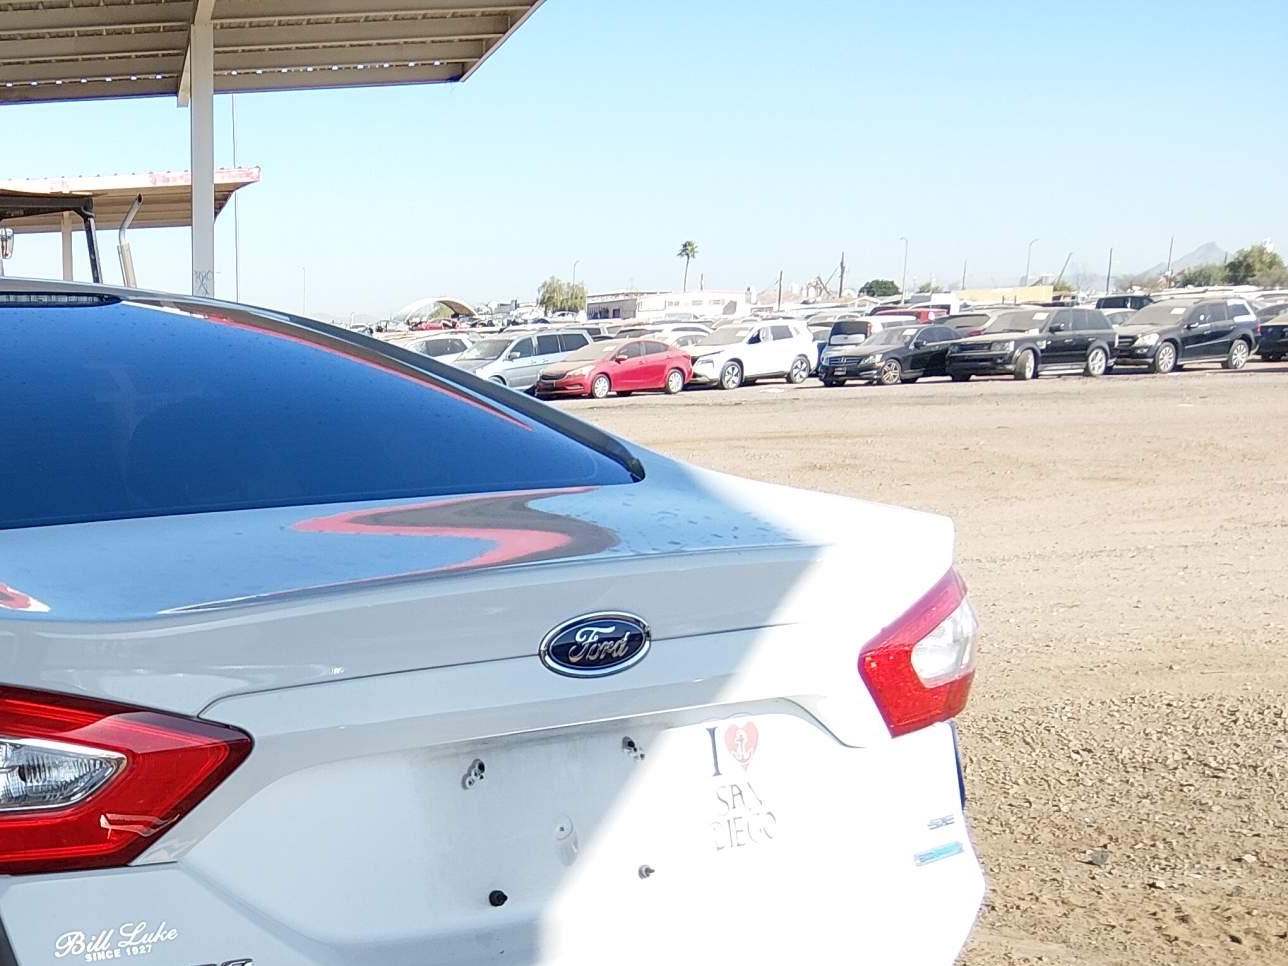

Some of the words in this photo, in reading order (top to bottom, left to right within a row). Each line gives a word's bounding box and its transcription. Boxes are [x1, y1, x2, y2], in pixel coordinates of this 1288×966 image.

[568, 625, 631, 663] Ford
[54, 928, 114, 958] Bill
[117, 921, 179, 948] Luke
[85, 948, 121, 962] SINCE
[126, 944, 153, 957] 1927
